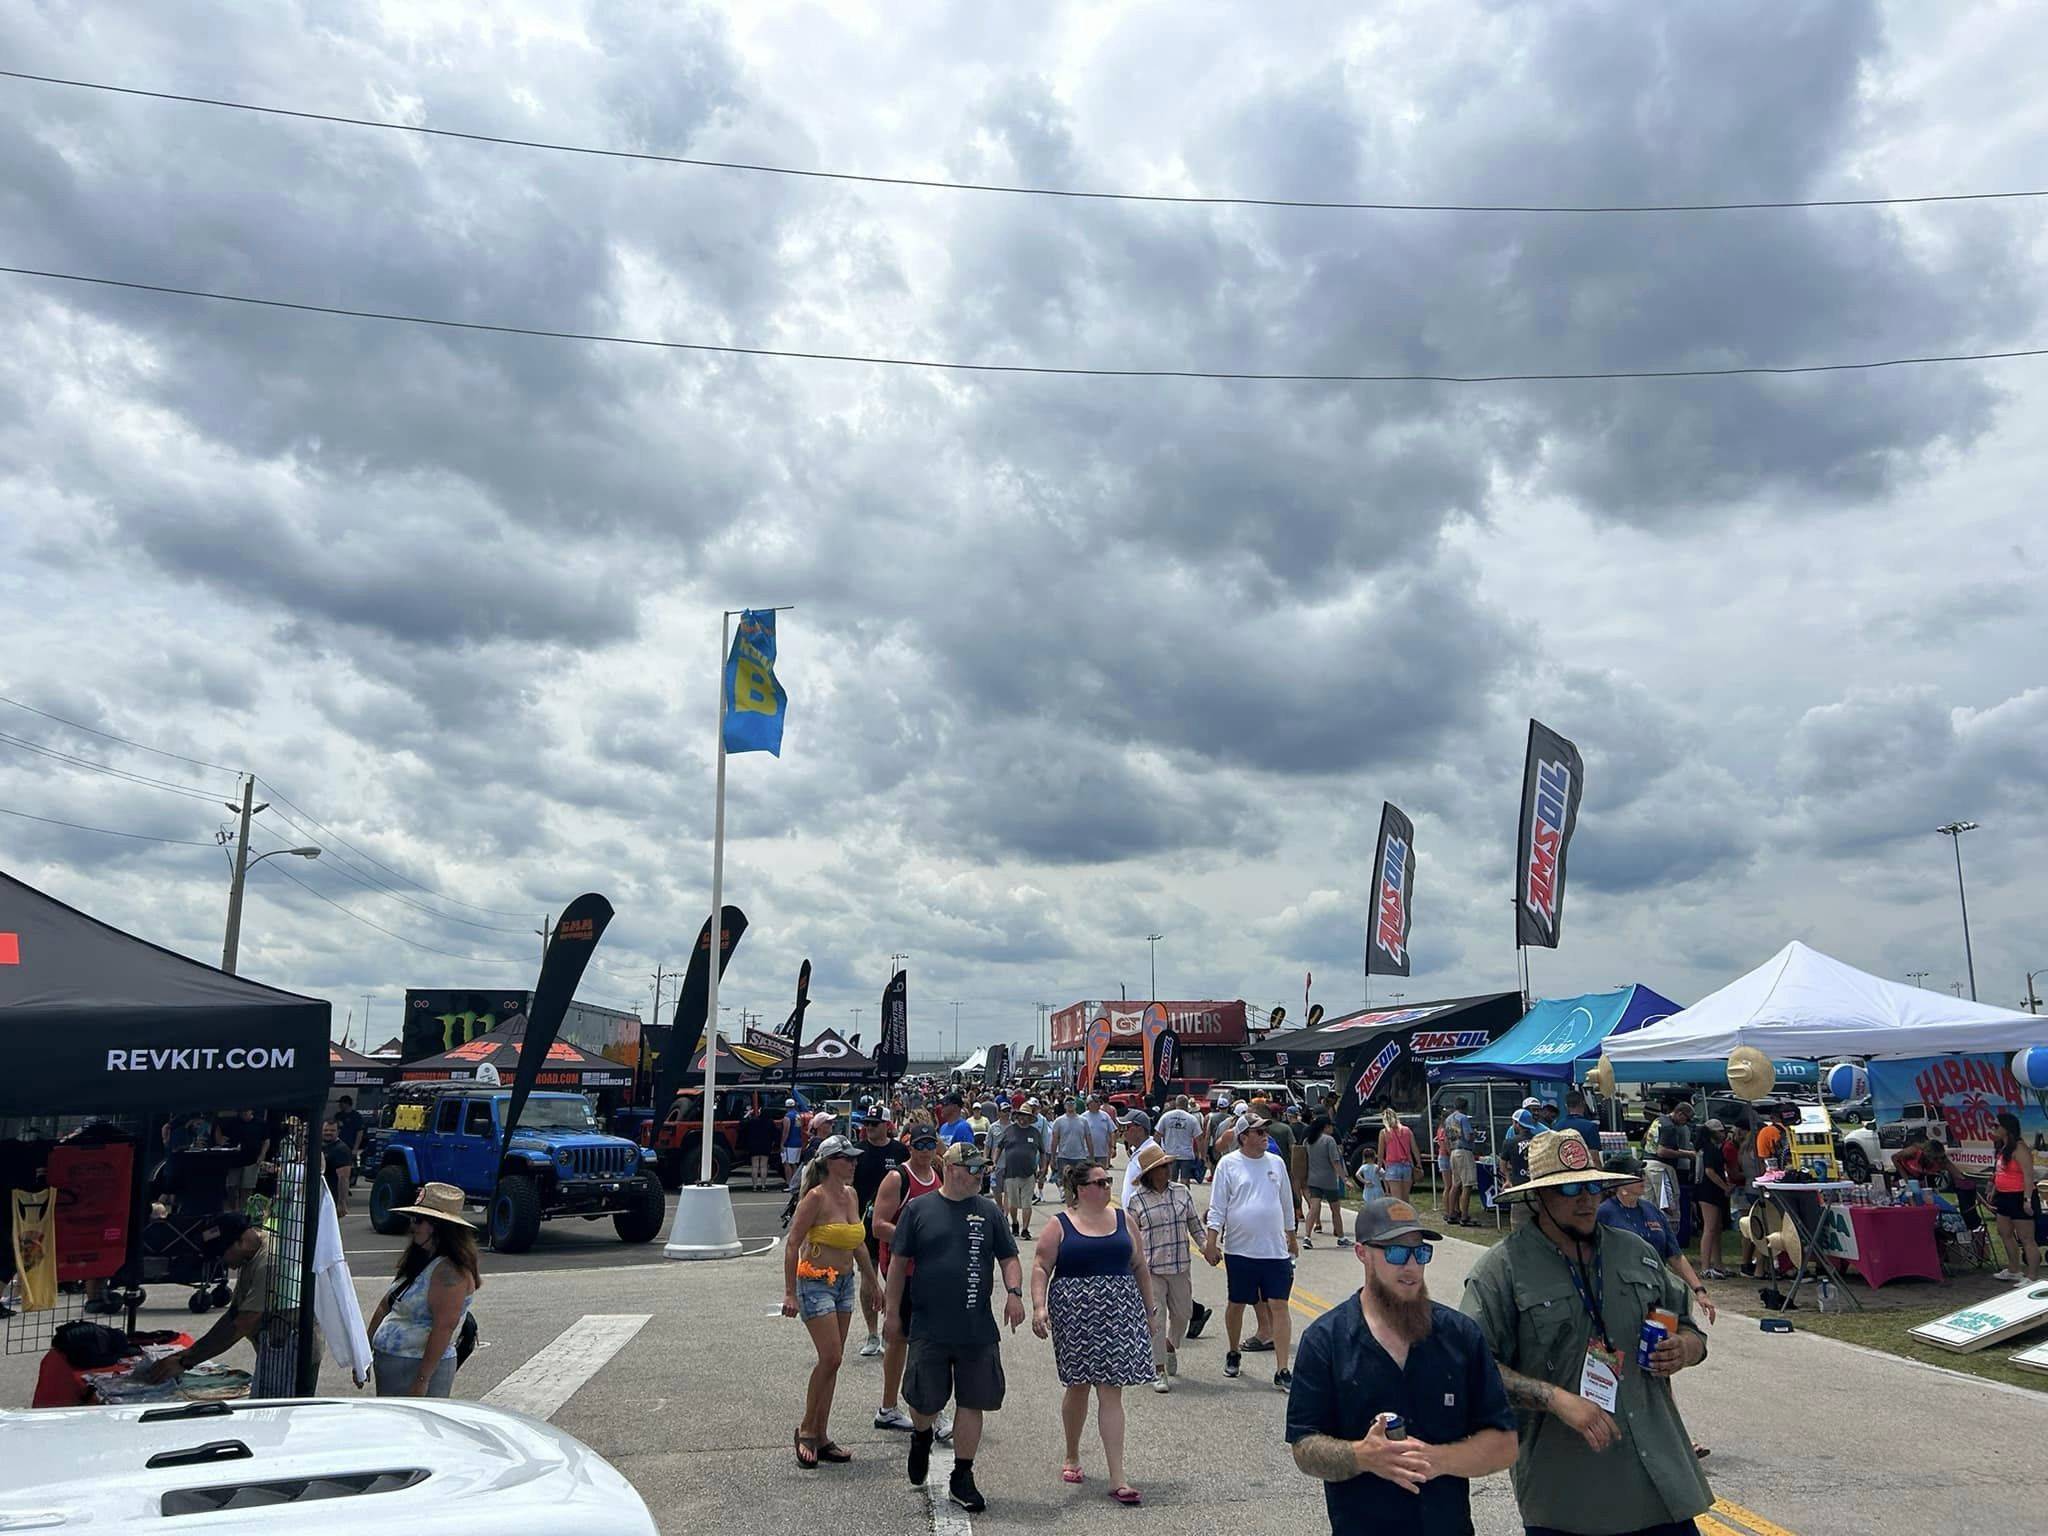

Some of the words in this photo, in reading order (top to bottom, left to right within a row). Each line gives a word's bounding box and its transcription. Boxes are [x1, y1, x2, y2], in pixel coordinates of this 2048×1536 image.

[1525, 758, 1571, 933] AMSOIL
[1376, 834, 1409, 966] AMSOIL
[1168, 1011, 1222, 1034] LIVERS
[1409, 1030, 1490, 1053] AMSOIL
[107, 1048, 295, 1071] REVKIT.COM
[750, 1032, 794, 1058] SKYJACK
[1159, 1035, 1175, 1085] AMSOIL
[1355, 1040, 1401, 1105] AMSOIL
[1915, 1058, 2025, 1111] HABANA
[1950, 1151, 1994, 1164] sunscreen
